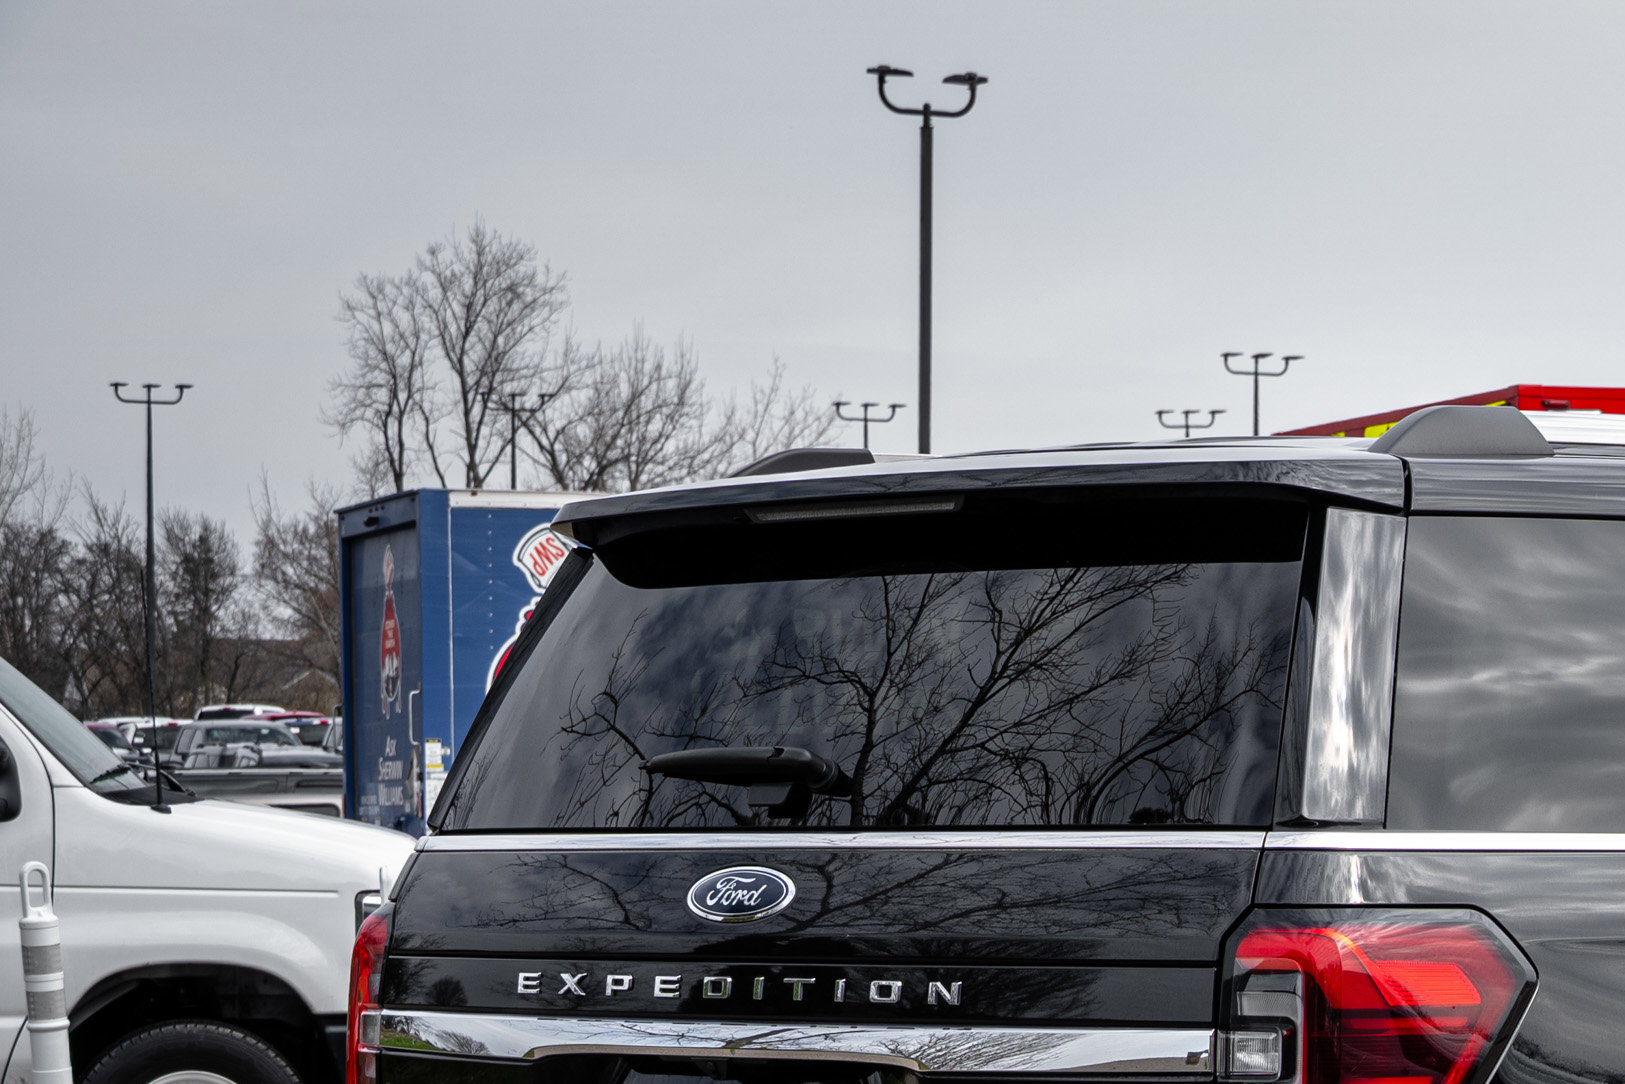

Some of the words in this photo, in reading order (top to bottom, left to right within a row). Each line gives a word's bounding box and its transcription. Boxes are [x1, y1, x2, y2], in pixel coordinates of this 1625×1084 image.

[529, 536, 566, 578] SWP
[706, 876, 768, 906] Ford
[517, 971, 962, 1006] EXPEDITION
